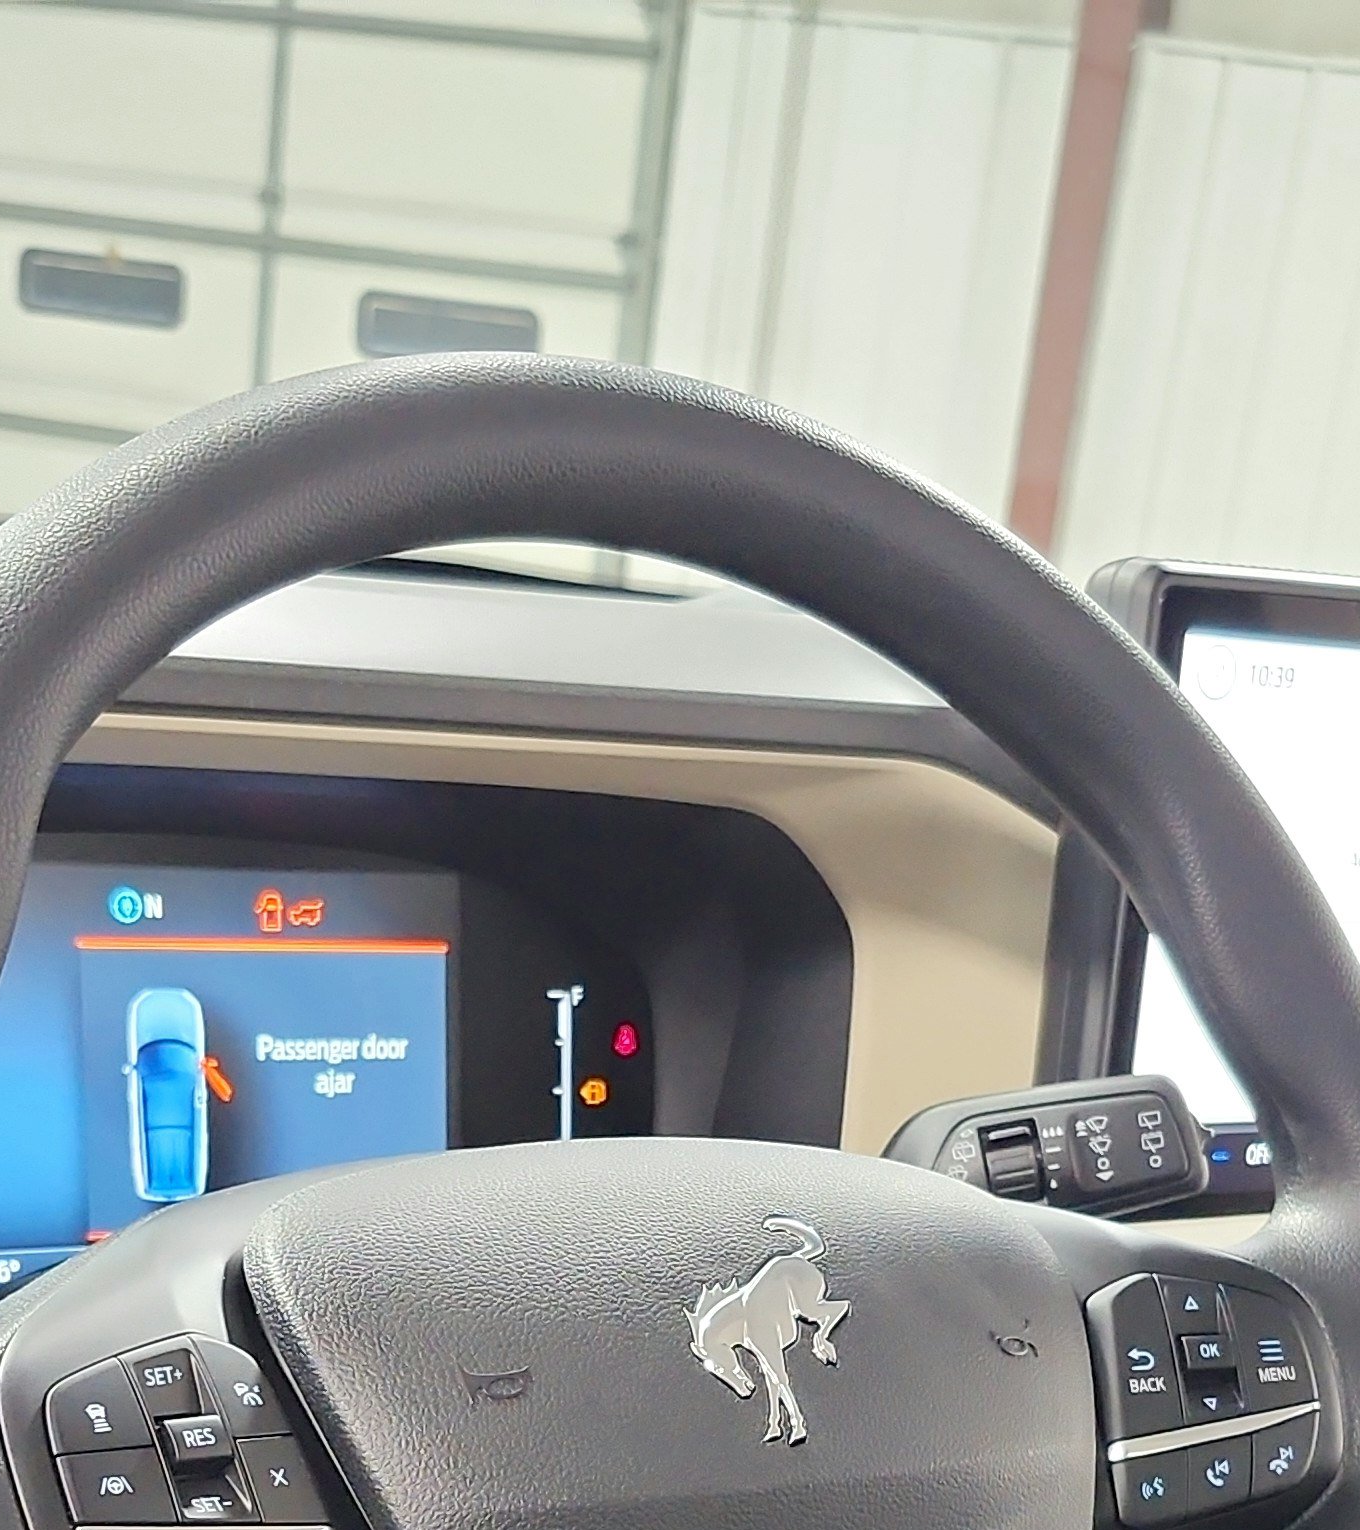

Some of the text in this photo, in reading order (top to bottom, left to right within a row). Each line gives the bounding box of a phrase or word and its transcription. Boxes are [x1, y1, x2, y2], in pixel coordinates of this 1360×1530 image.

[1250, 664, 1296, 689] 10:39
[255, 1032, 408, 1064] Passenger door
[313, 1068, 356, 1099] ajar
[1199, 1342, 1221, 1359] OK
[143, 1364, 184, 1388] SET+
[1128, 1376, 1167, 1394] BACK
[1257, 1365, 1296, 1383] MENU
[182, 1426, 217, 1448] RES
